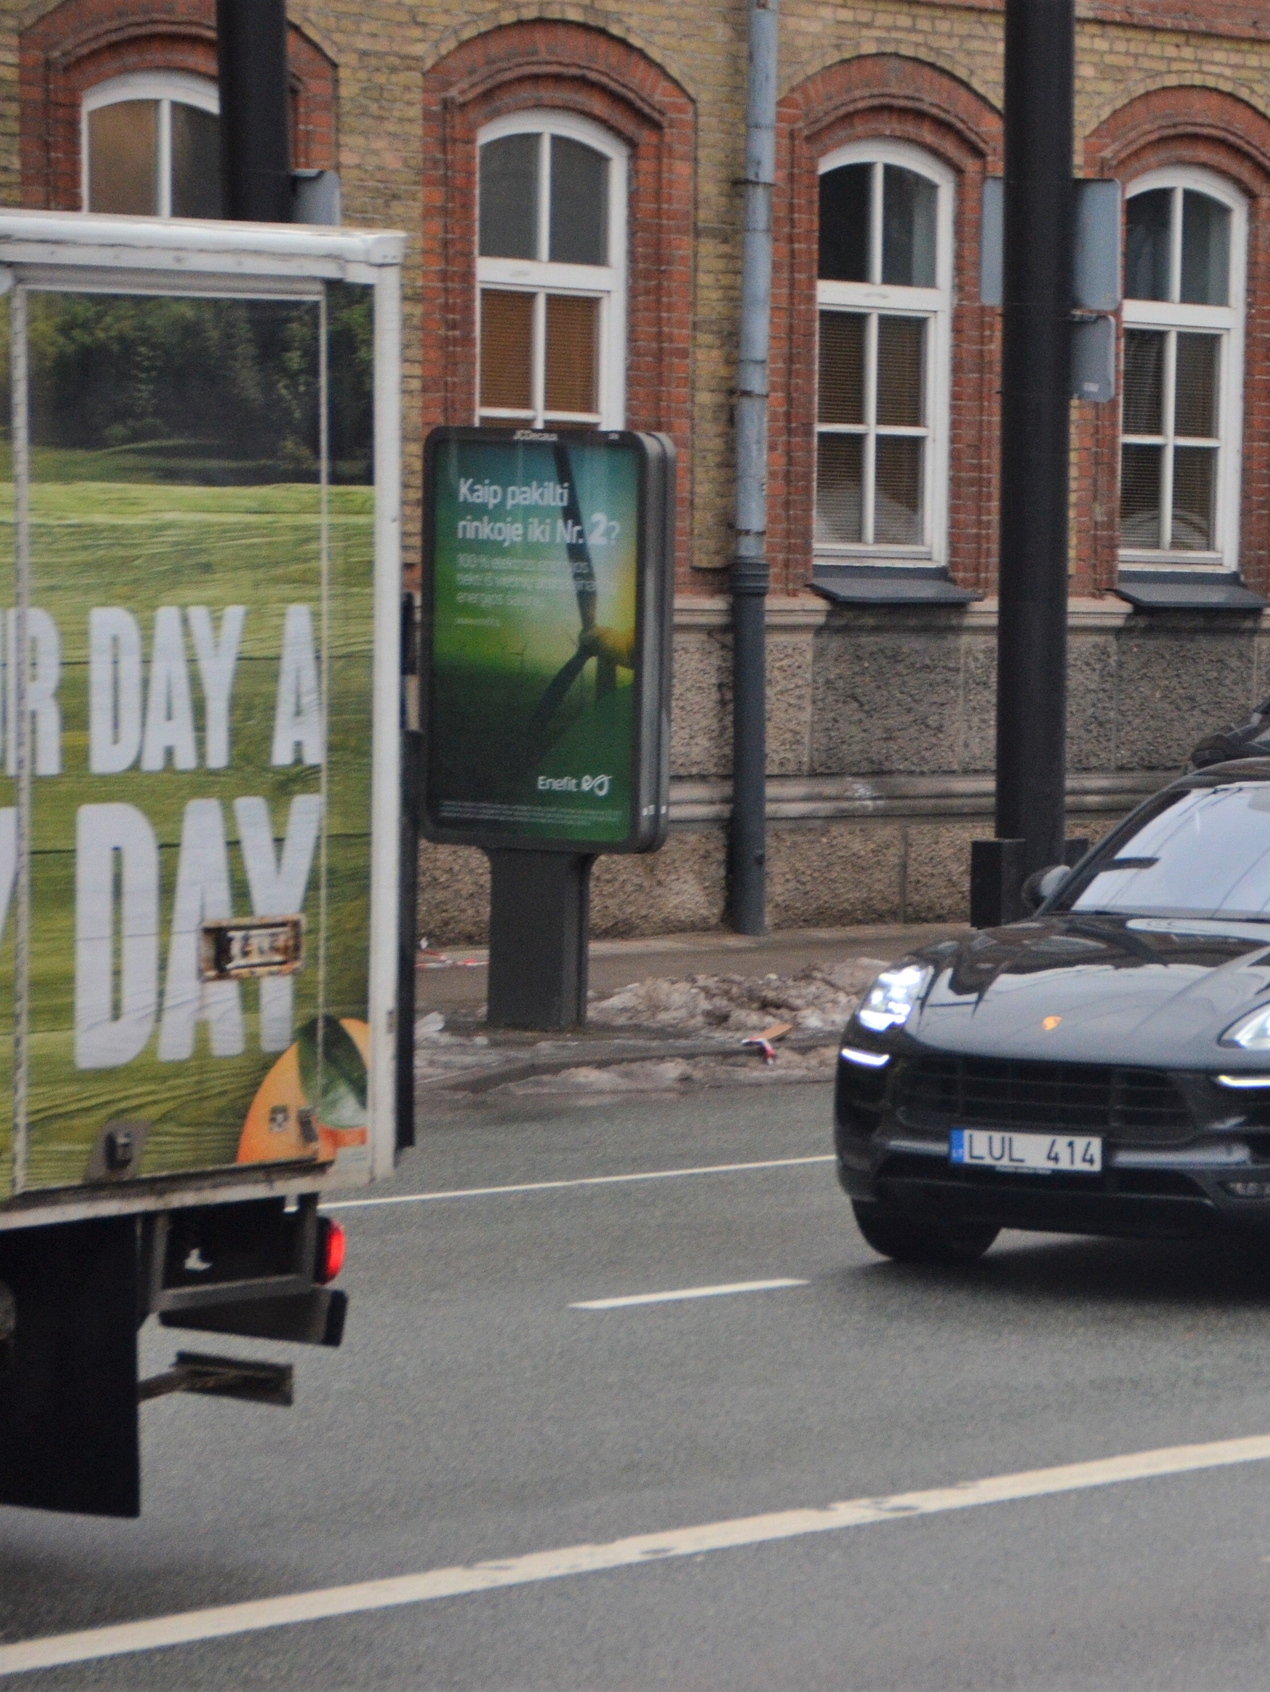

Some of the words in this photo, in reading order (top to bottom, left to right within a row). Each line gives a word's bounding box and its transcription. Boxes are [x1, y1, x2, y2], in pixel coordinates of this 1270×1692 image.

[458, 478, 501, 509] Kaip
[506, 481, 570, 510] pakilti
[458, 515, 523, 547] rinkoje
[528, 518, 550, 543] iki
[556, 519, 584, 544] Nr.
[0, 606, 63, 776] R
[88, 605, 247, 776] DAY
[271, 602, 325, 767] A
[537, 776, 579, 791] Enefit
[74, 793, 325, 1071] DAY
[968, 1133, 1026, 1163] LUL
[1046, 1138, 1096, 1167] 414
